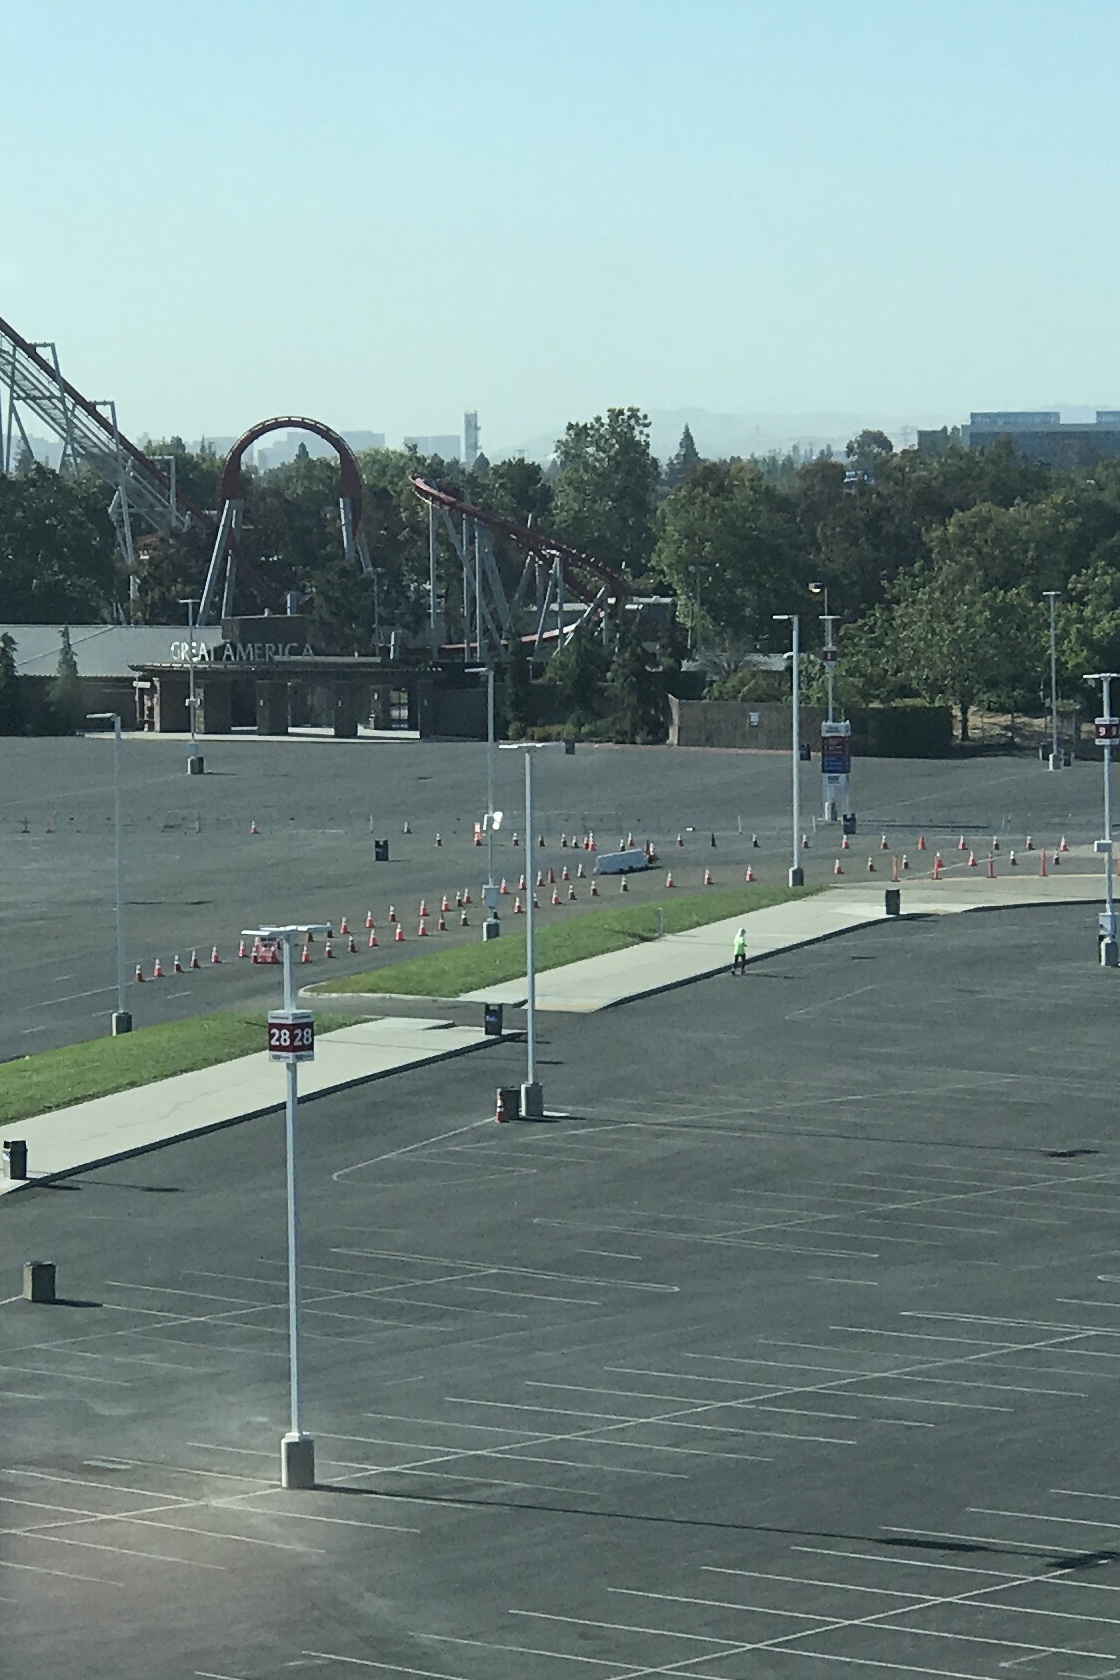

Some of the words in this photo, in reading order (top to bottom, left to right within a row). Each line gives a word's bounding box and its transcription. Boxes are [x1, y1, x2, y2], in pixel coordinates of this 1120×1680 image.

[170, 641, 215, 662] GREAT
[222, 643, 315, 661] AMERICA
[270, 1028, 290, 1047] 28
[293, 1027, 312, 1047] 28
